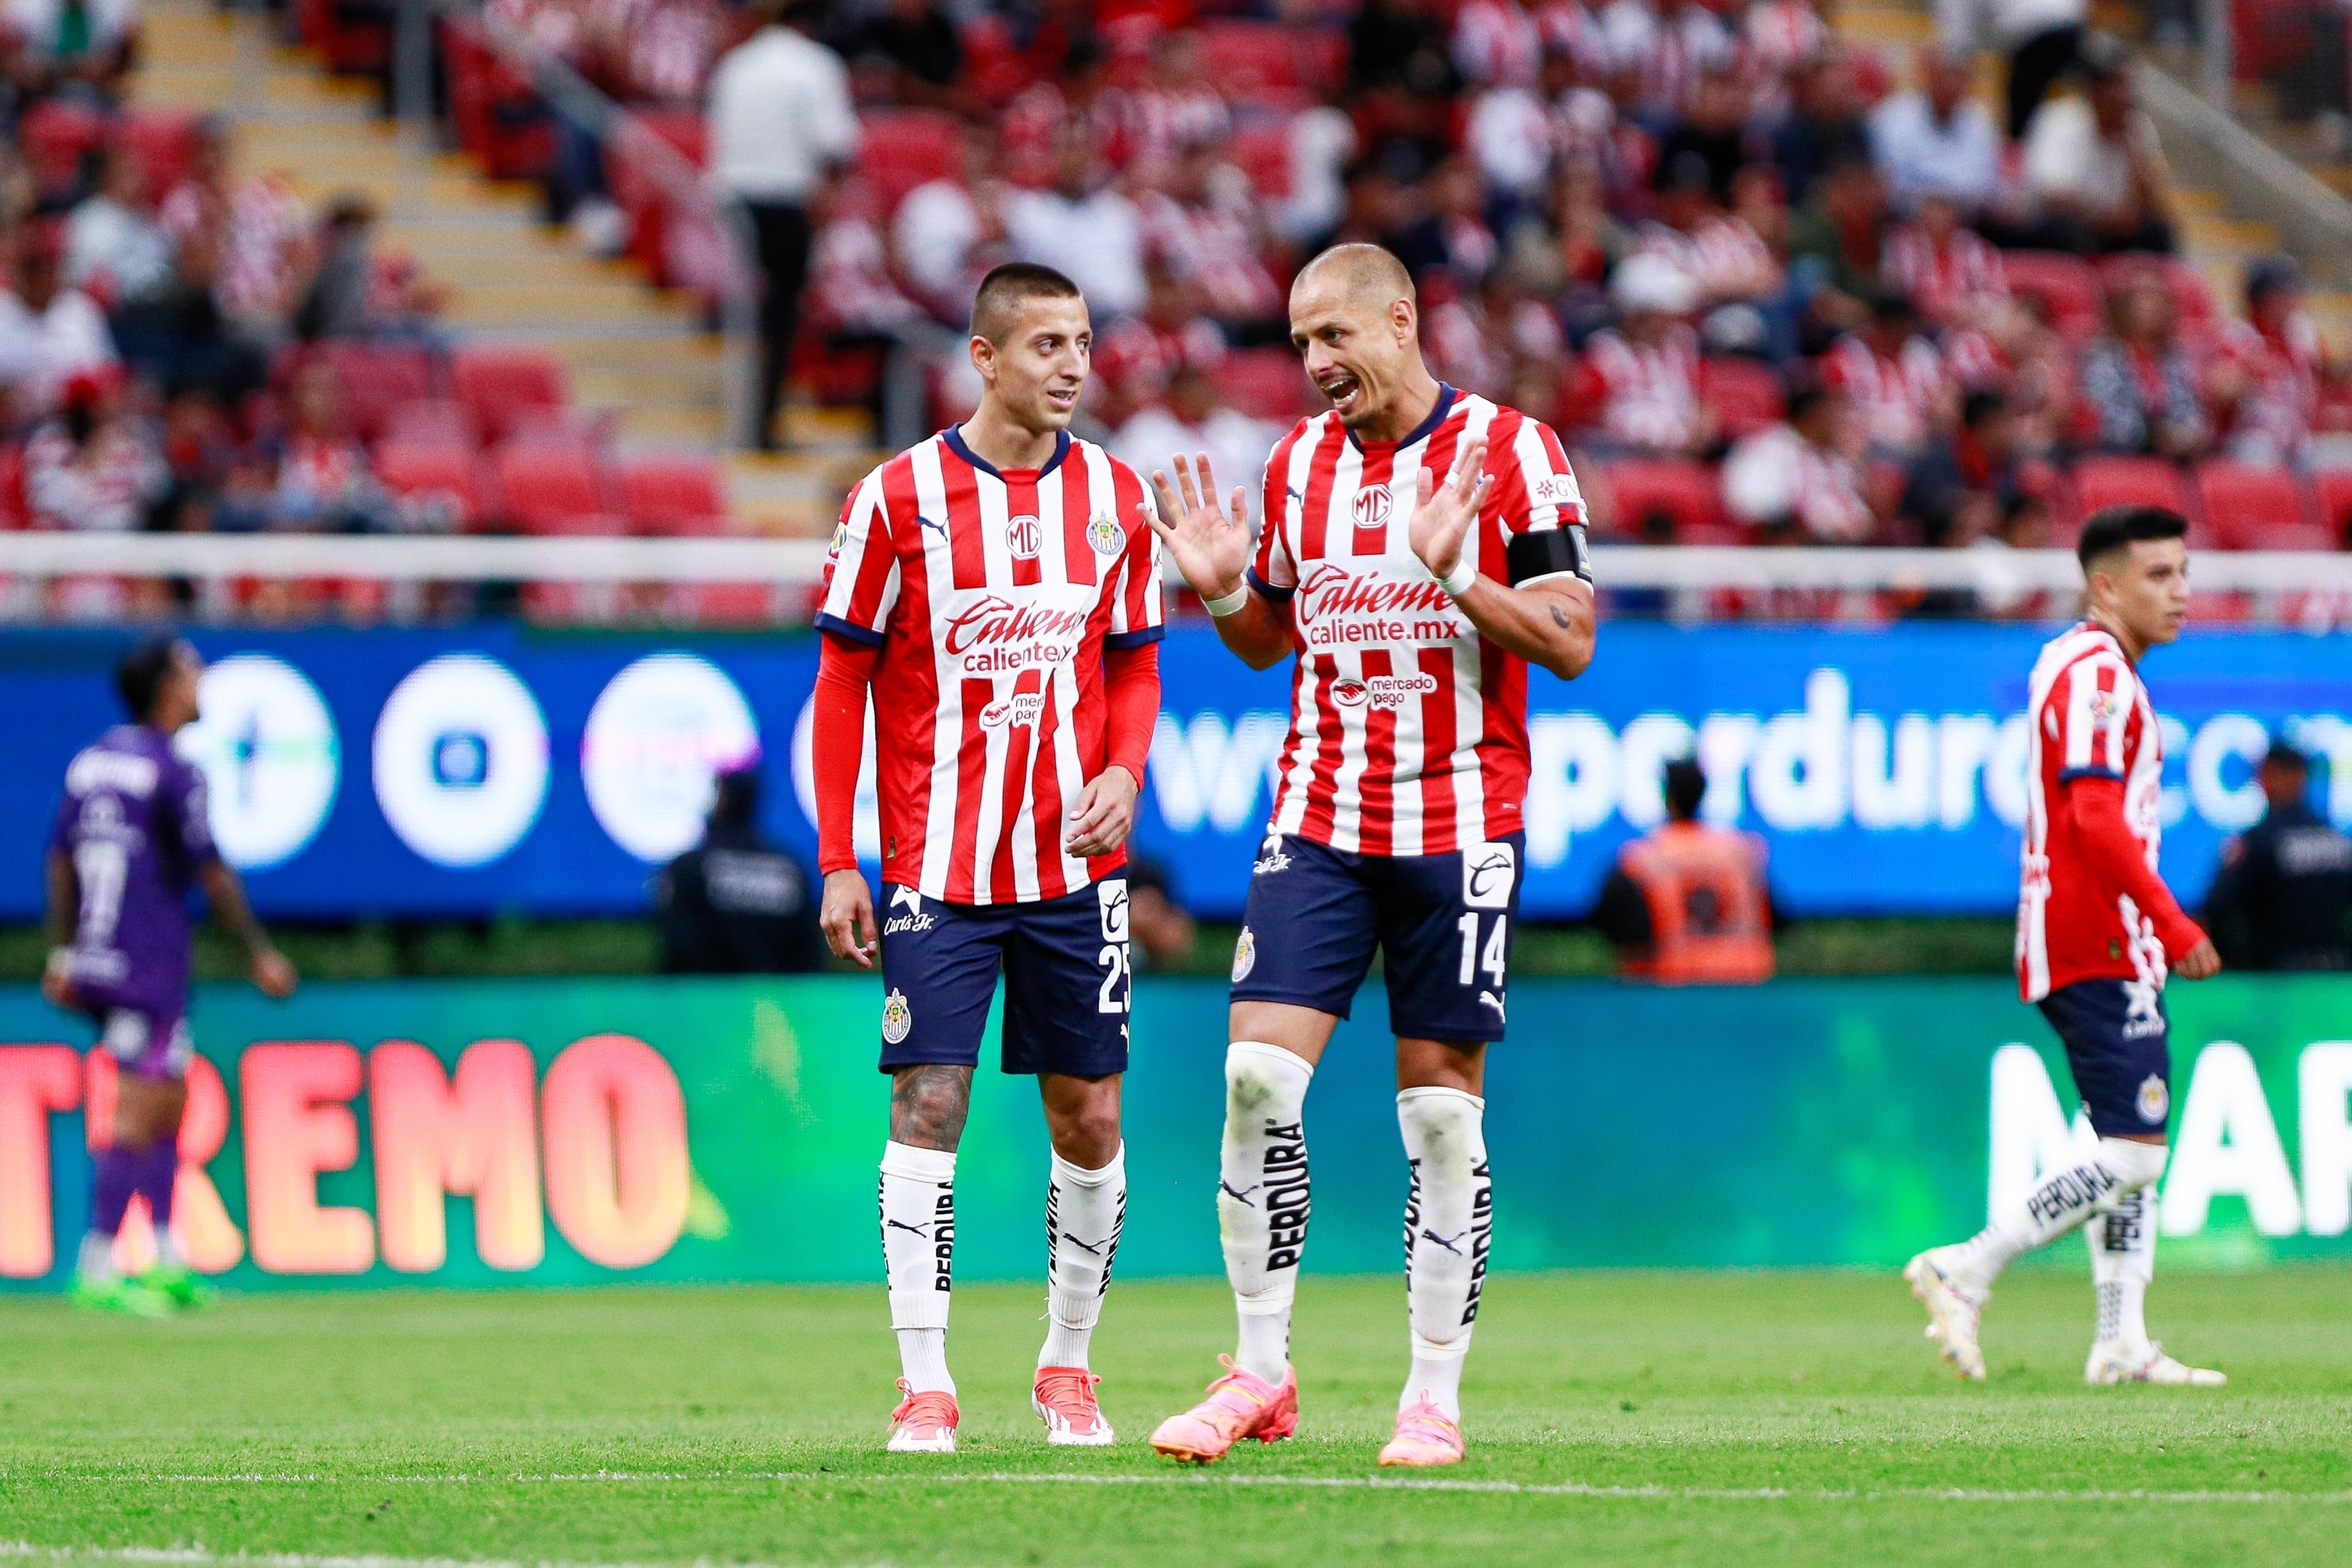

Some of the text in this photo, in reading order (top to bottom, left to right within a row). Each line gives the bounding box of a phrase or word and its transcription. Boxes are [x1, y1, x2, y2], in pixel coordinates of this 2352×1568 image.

[1356, 489, 1389, 522] MG
[1310, 618, 1461, 645] caliente.mx
[1371, 677, 1433, 691] mercado
[1374, 693, 1405, 706] pago
[884, 913, 934, 936] Carl's Jr.
[1458, 911, 1506, 987] 14
[1264, 1122, 1311, 1272] PERDURA
